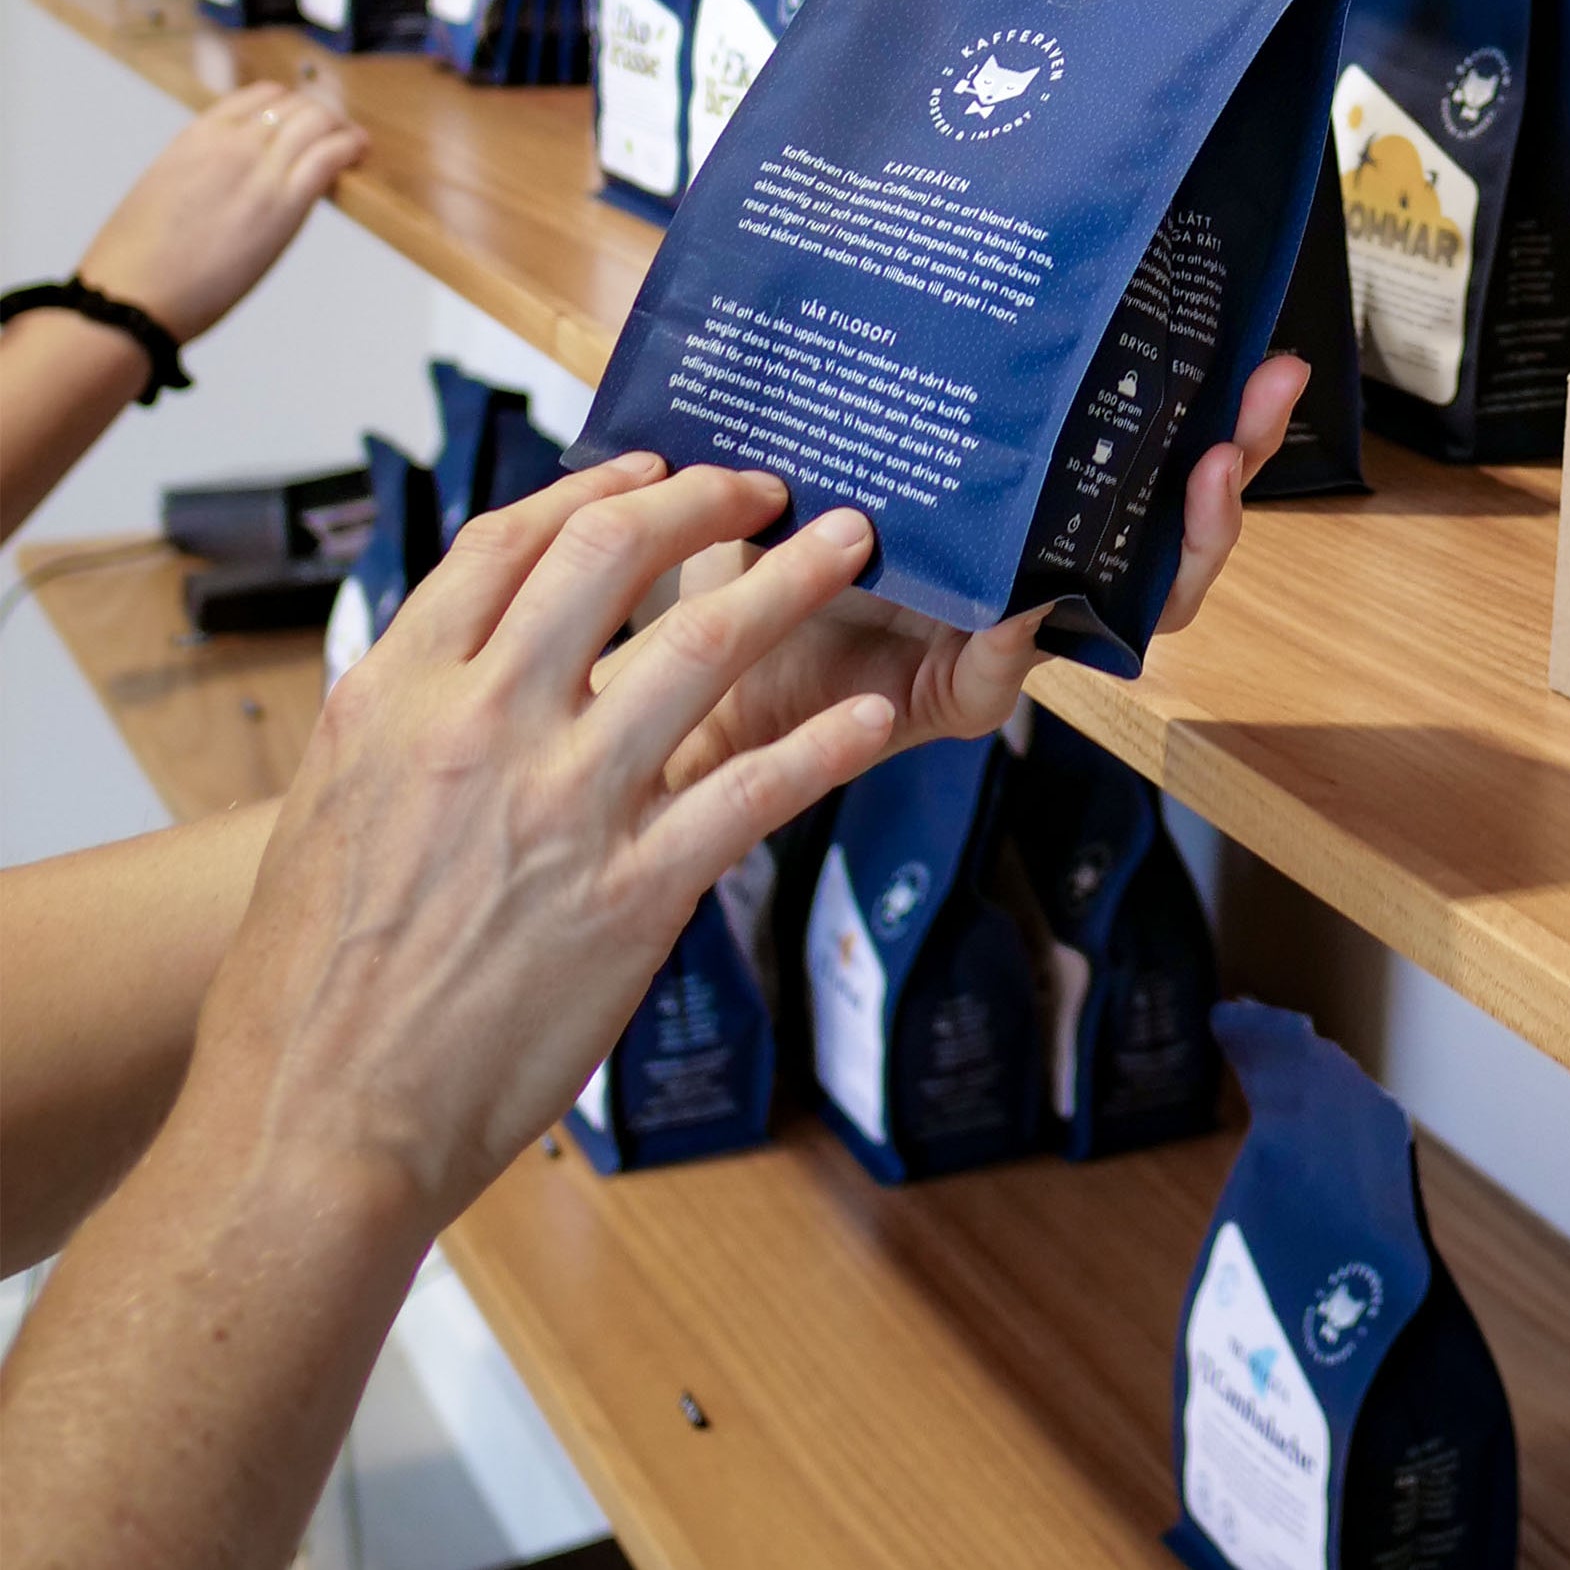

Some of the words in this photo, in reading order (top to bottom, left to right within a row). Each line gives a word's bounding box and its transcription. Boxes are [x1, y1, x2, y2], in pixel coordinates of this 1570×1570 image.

[961, 29, 1065, 81] KAFFERÄVEN
[970, 111, 1032, 141] IMPORT
[759, 160, 783, 176] som
[780, 163, 818, 188] bland
[813, 180, 852, 202] annat
[847, 191, 922, 225] kännetecknas
[920, 213, 938, 228] av
[935, 218, 954, 233] en
[951, 223, 984, 244] extra
[981, 230, 1028, 261] känslig
[1025, 248, 1055, 271] nos,
[780, 143, 844, 179] Kafferäven
[840, 169, 883, 193] (Vulpes
[881, 180, 933, 208] Coffeum)
[928, 193, 947, 210] är
[943, 200, 962, 215] en
[959, 205, 981, 220] art
[976, 206, 1016, 231] bland
[1011, 219, 1051, 243] rävar
[881, 160, 972, 194] KAFFERÄVEN
[1178, 210, 1213, 229] LÄTT
[737, 217, 773, 237] utvald
[769, 226, 802, 247] skörd
[797, 237, 824, 255] som
[821, 245, 859, 268] sedan
[857, 255, 885, 276] förs
[881, 264, 928, 292] tillbaka
[926, 279, 946, 298] till
[941, 287, 982, 311] grytet
[986, 303, 1019, 326] norr.
[740, 197, 771, 215] reser
[767, 202, 807, 227] årligen
[804, 218, 834, 235] runt
[832, 226, 895, 258] tropikerna
[892, 244, 914, 264] för
[910, 253, 932, 272] att
[928, 260, 968, 283] samla
[966, 269, 981, 288] in
[980, 277, 999, 295] en
[998, 284, 1036, 309] noga
[753, 177, 814, 211] oklanderlig
[810, 198, 834, 215] stil
[829, 206, 854, 223] och
[849, 212, 876, 228] stor
[870, 219, 910, 241] social
[903, 227, 971, 265] kompetens.
[971, 248, 1042, 288] Kafferäven
[1345, 198, 1462, 269] OMMAR
[711, 294, 724, 311] Vi
[720, 298, 738, 316] vill
[735, 305, 755, 321] att
[752, 309, 775, 328] du
[771, 316, 794, 338] ska
[792, 325, 837, 352] uppleva
[835, 338, 858, 359] hur
[855, 349, 901, 376] smaken
[897, 365, 919, 385] på
[917, 370, 946, 392] vårt
[943, 377, 979, 404] kaffe
[800, 297, 828, 323] VÅR
[827, 309, 898, 348] FILOSOFI
[1118, 332, 1159, 362] BRYGG
[680, 354, 762, 393] odlingsplatsen
[762, 383, 786, 401] och
[782, 388, 842, 425] hantverket.
[842, 410, 856, 429] Vi
[852, 415, 900, 446] handlar
[897, 432, 935, 459] direkt
[933, 445, 963, 469] från
[684, 333, 729, 357] specifikt
[723, 344, 745, 365] för
[741, 354, 765, 371] att
[762, 356, 792, 380] lyfta
[790, 367, 818, 391] fram
[816, 378, 840, 400] den
[836, 385, 886, 417] karaktär
[883, 406, 910, 428] som
[908, 412, 961, 445] formats
[960, 433, 981, 451] av
[703, 317, 743, 340] speglar
[740, 328, 772, 351] dess
[771, 340, 824, 372] ursprung.
[824, 357, 838, 375] Vi
[834, 364, 870, 387] rostar
[866, 374, 907, 401] därför
[904, 388, 937, 413] varje
[936, 398, 972, 426] kaffe
[1117, 397, 1144, 419] gram
[668, 371, 709, 399] gårdar,
[707, 387, 810, 433] process-stationer
[806, 423, 829, 442] och
[825, 432, 887, 465] exportörer
[884, 454, 911, 475] som
[910, 461, 942, 487] drivs
[941, 475, 961, 492] av
[669, 396, 750, 435] passionerade
[746, 424, 801, 453] personer
[798, 443, 822, 463] som
[818, 452, 855, 476] också
[853, 462, 871, 481] är
[868, 469, 897, 492] våra
[896, 481, 939, 509] vänner.
[1112, 413, 1141, 435] vatten
[711, 431, 738, 452] Gör
[736, 440, 766, 465] dem
[765, 452, 798, 478] stolta,
[796, 465, 820, 485] njut
[818, 475, 836, 491] av
[834, 479, 855, 499] din
[854, 484, 888, 512] kopp!
[1076, 478, 1101, 500] kaffe
